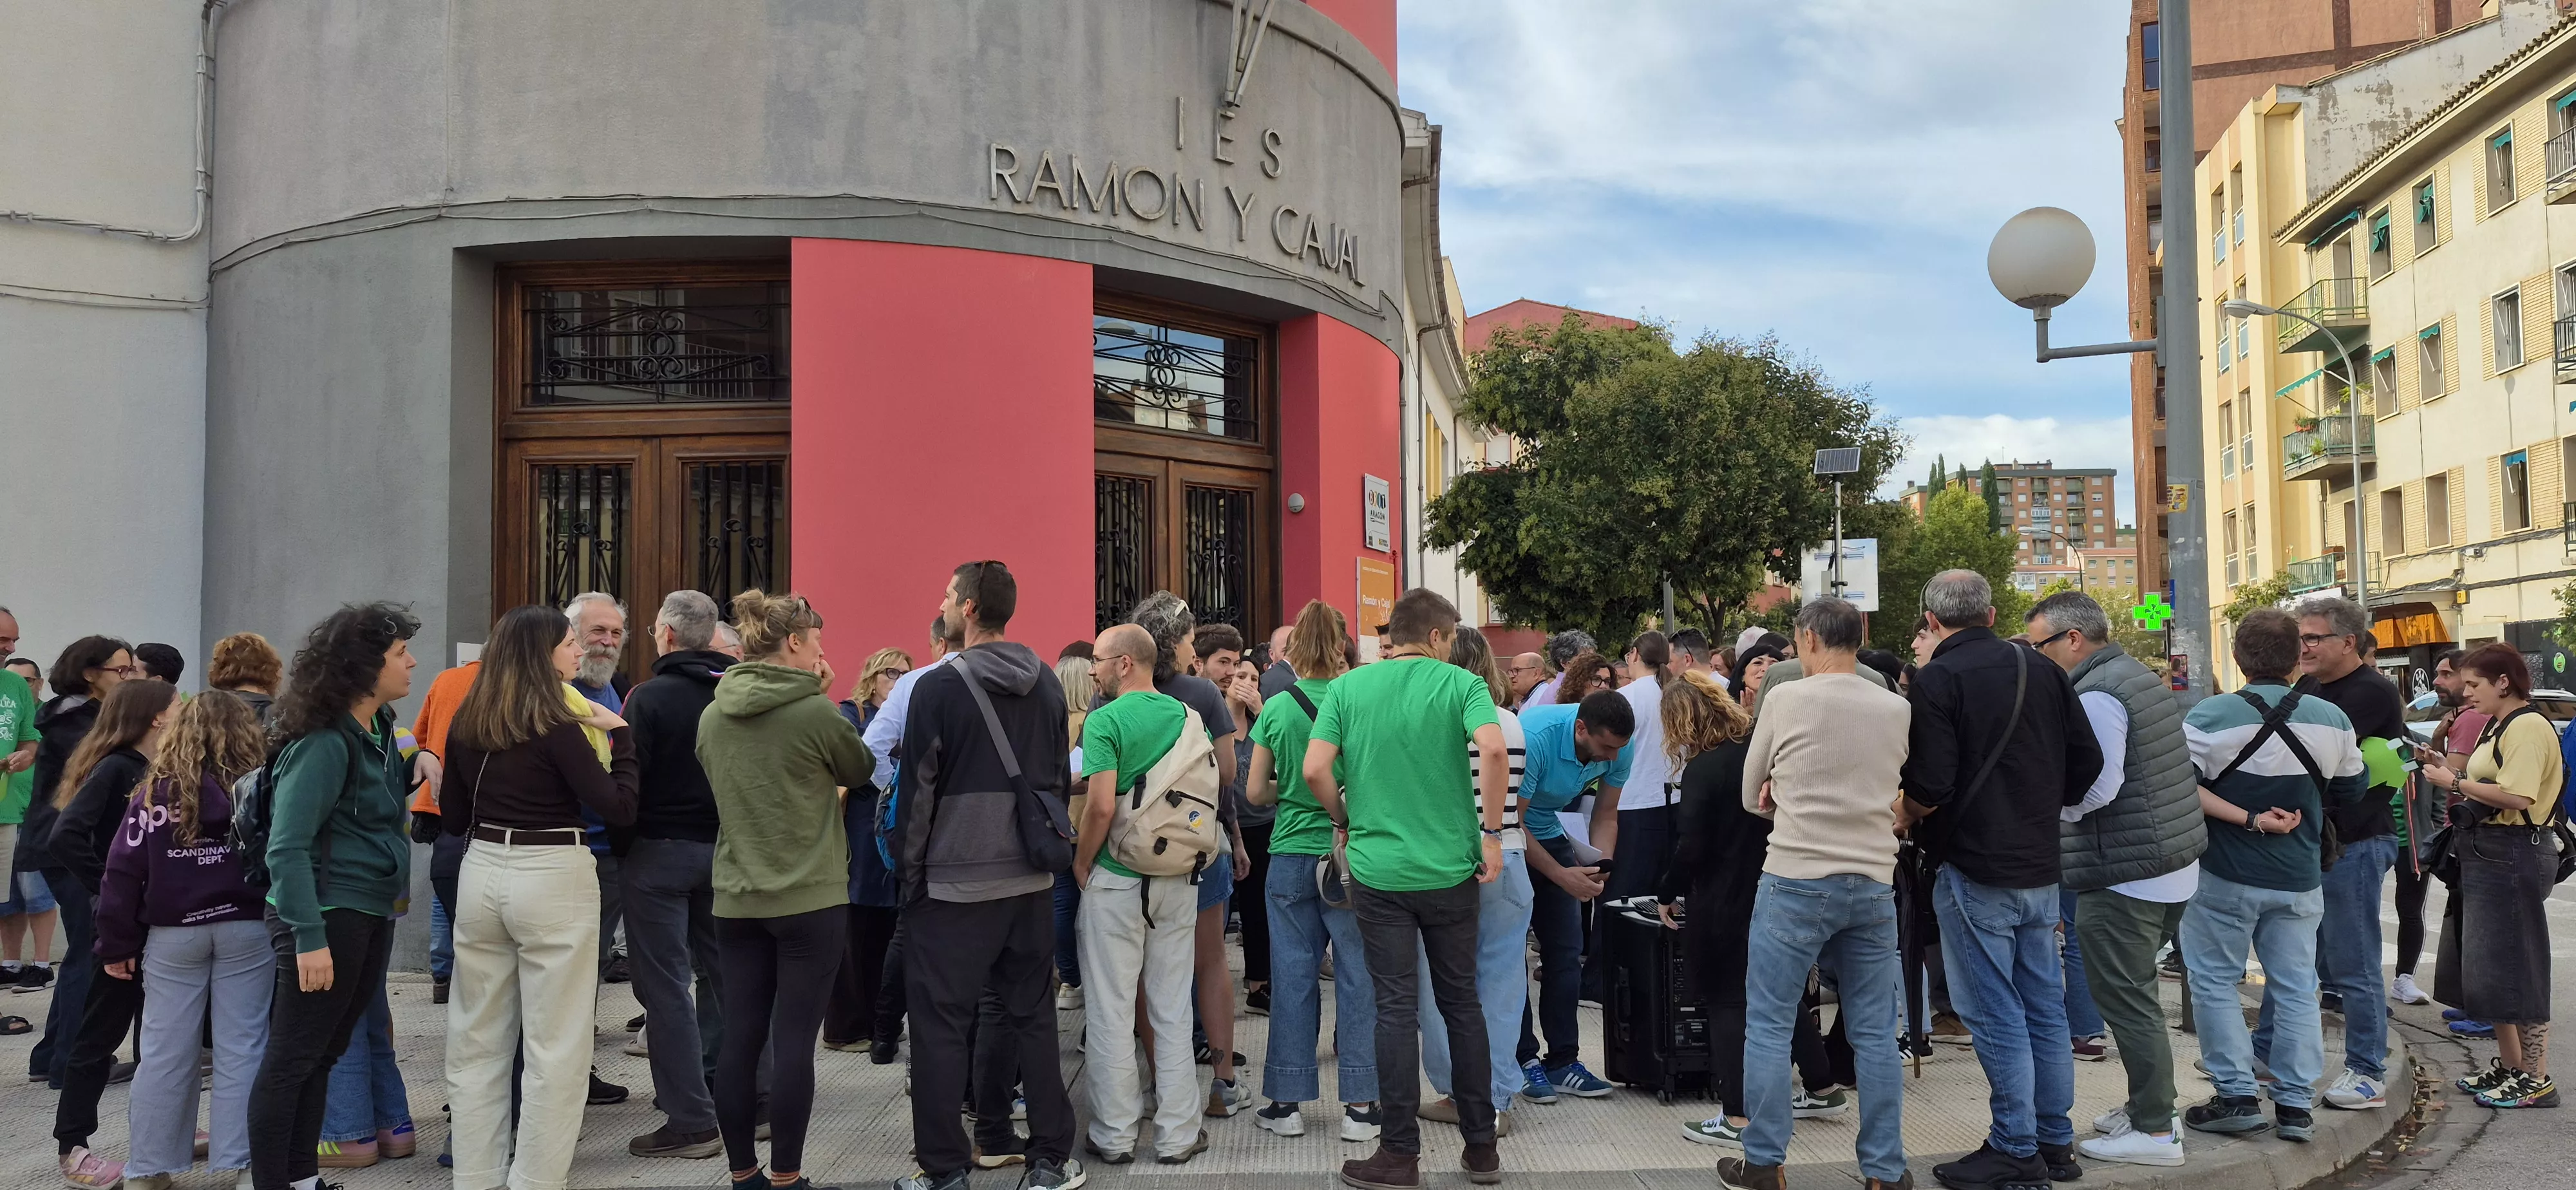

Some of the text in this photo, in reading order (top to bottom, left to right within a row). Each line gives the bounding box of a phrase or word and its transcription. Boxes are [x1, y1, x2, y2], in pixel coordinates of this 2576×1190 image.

[989, 142, 1366, 288] RAMON Y CAJAL
[198, 855, 225, 865] DEPT.
